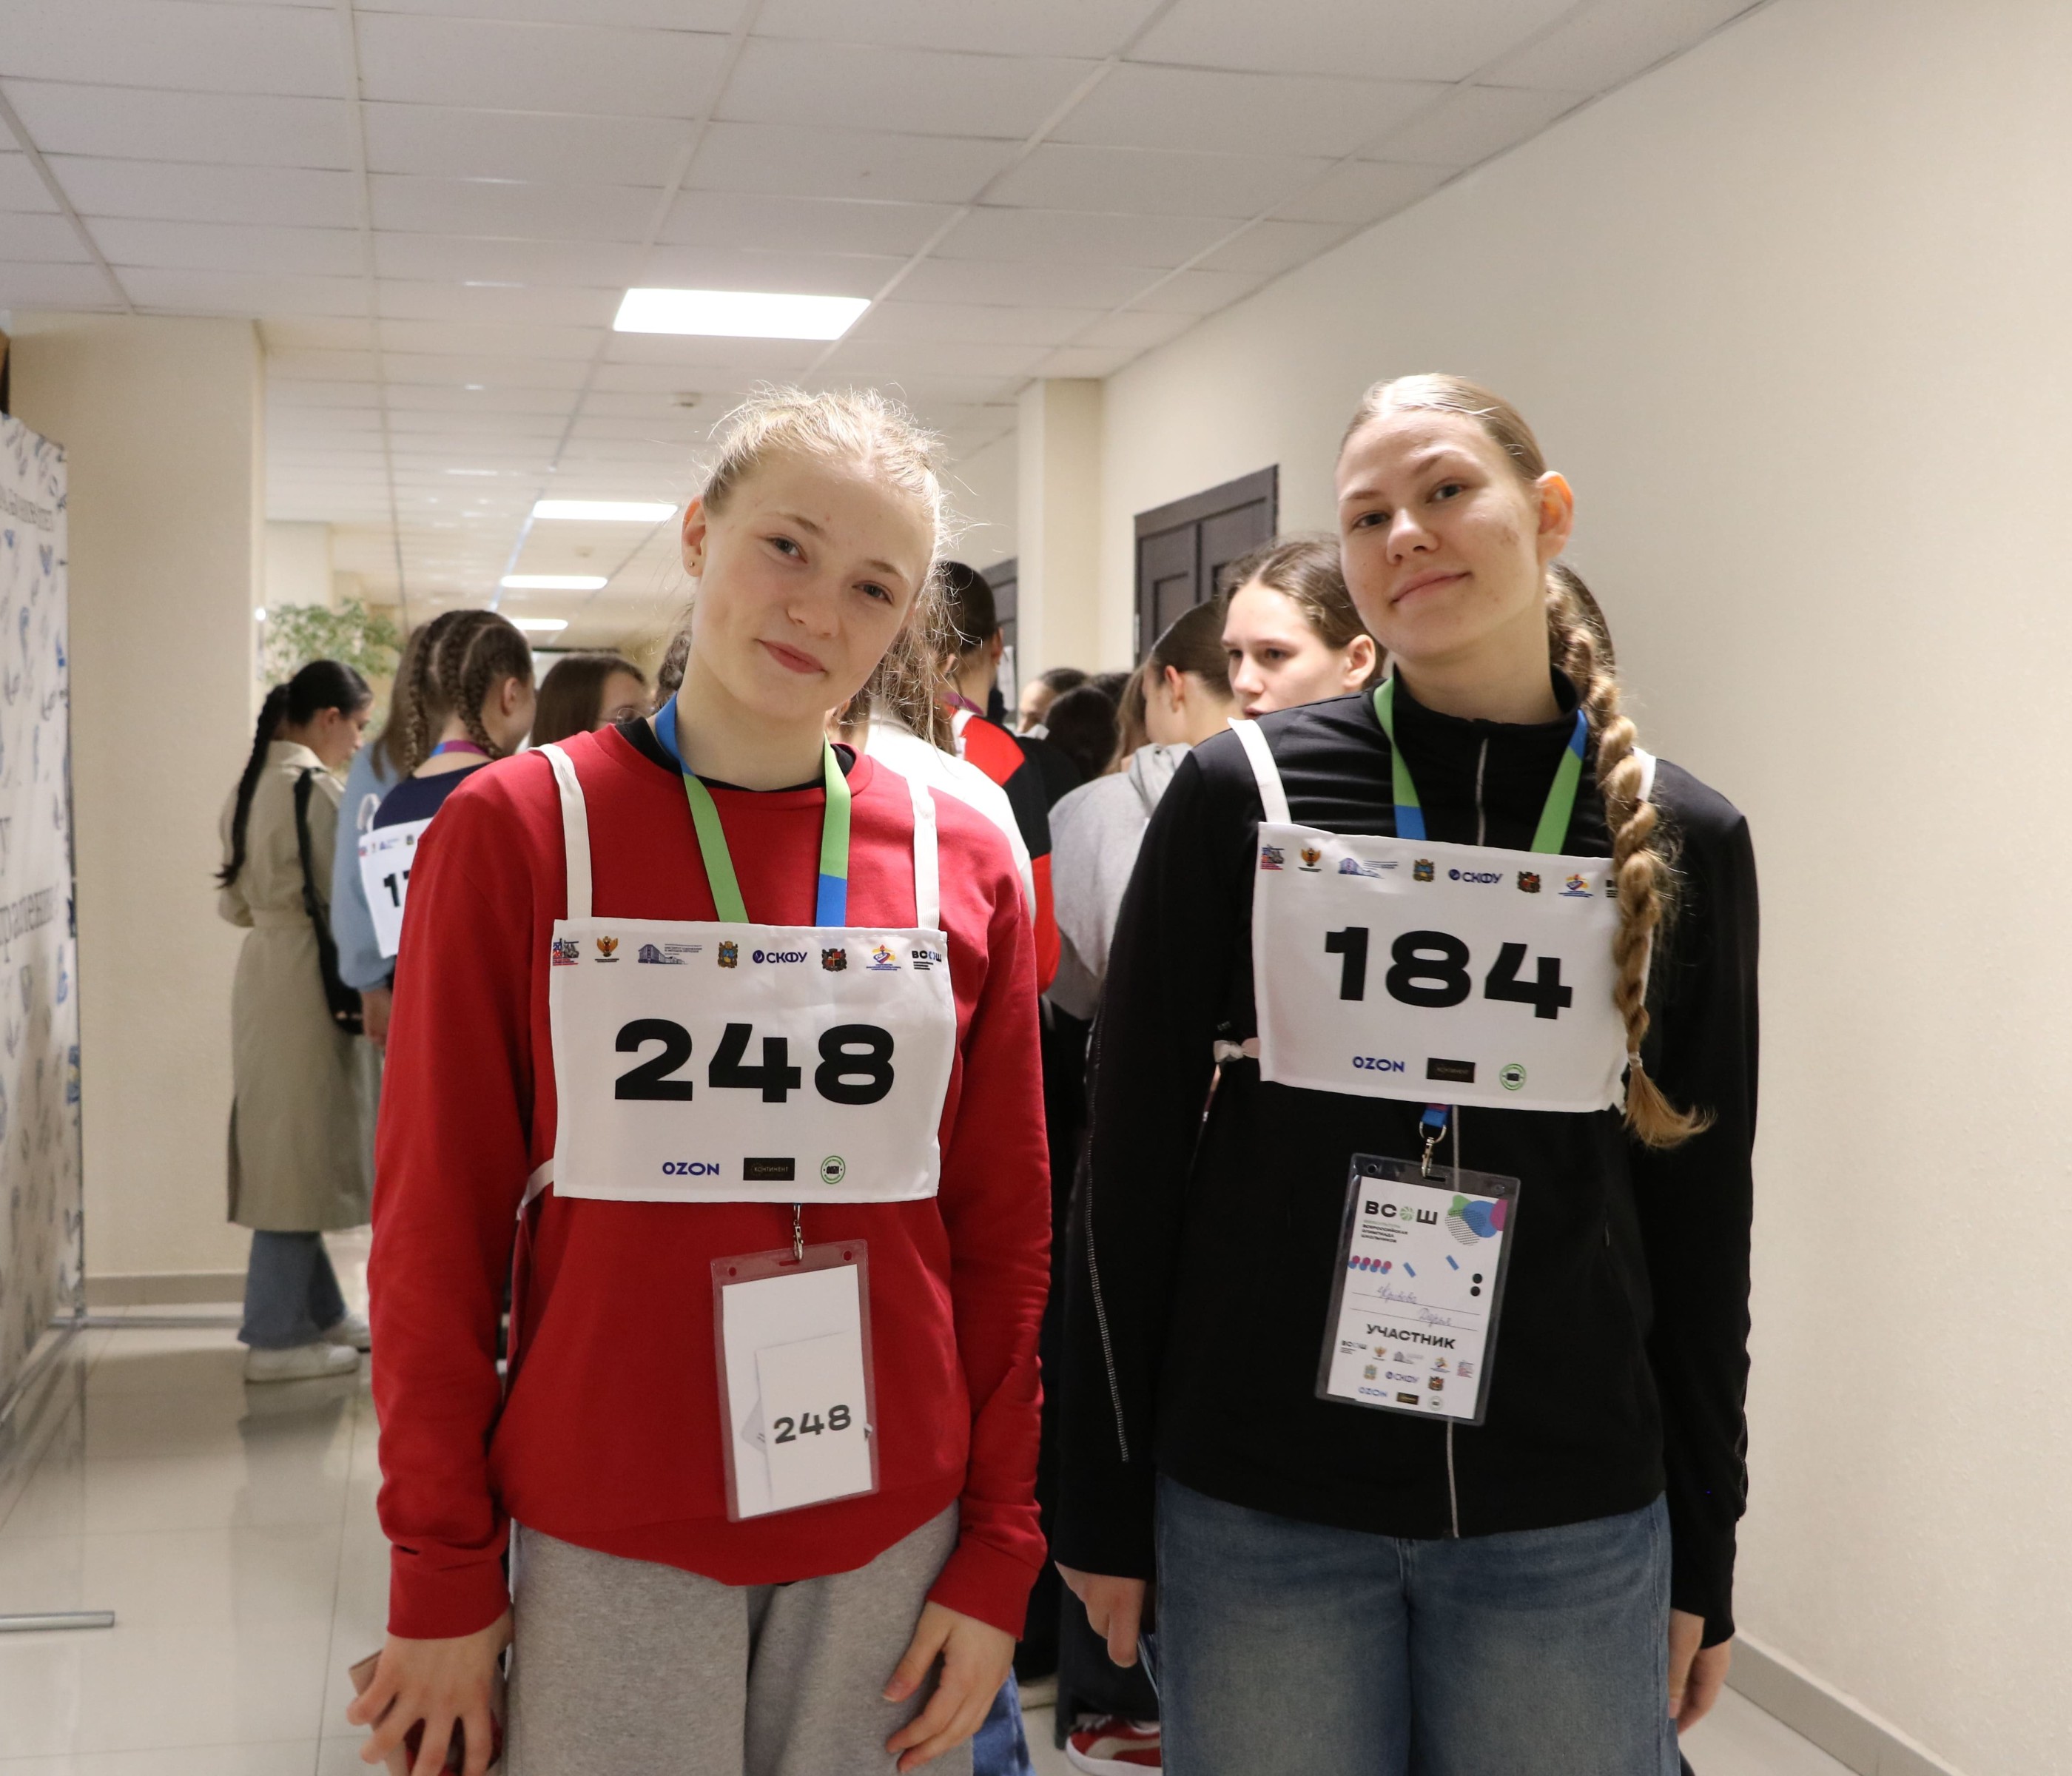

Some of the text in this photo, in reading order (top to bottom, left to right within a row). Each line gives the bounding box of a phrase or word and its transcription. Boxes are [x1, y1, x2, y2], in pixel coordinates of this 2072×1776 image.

[383, 870, 410, 907] 1
[1462, 872, 1503, 884] СКФУ
[766, 952, 808, 963] СКФУ
[1325, 926, 1572, 1020] 184
[615, 1018, 895, 1105] 248
[1352, 1056, 1405, 1073] OZON
[662, 1161, 720, 1176] OZON
[1367, 1323, 1456, 1349] УЧАСТНИК
[773, 1405, 851, 1444] 248
